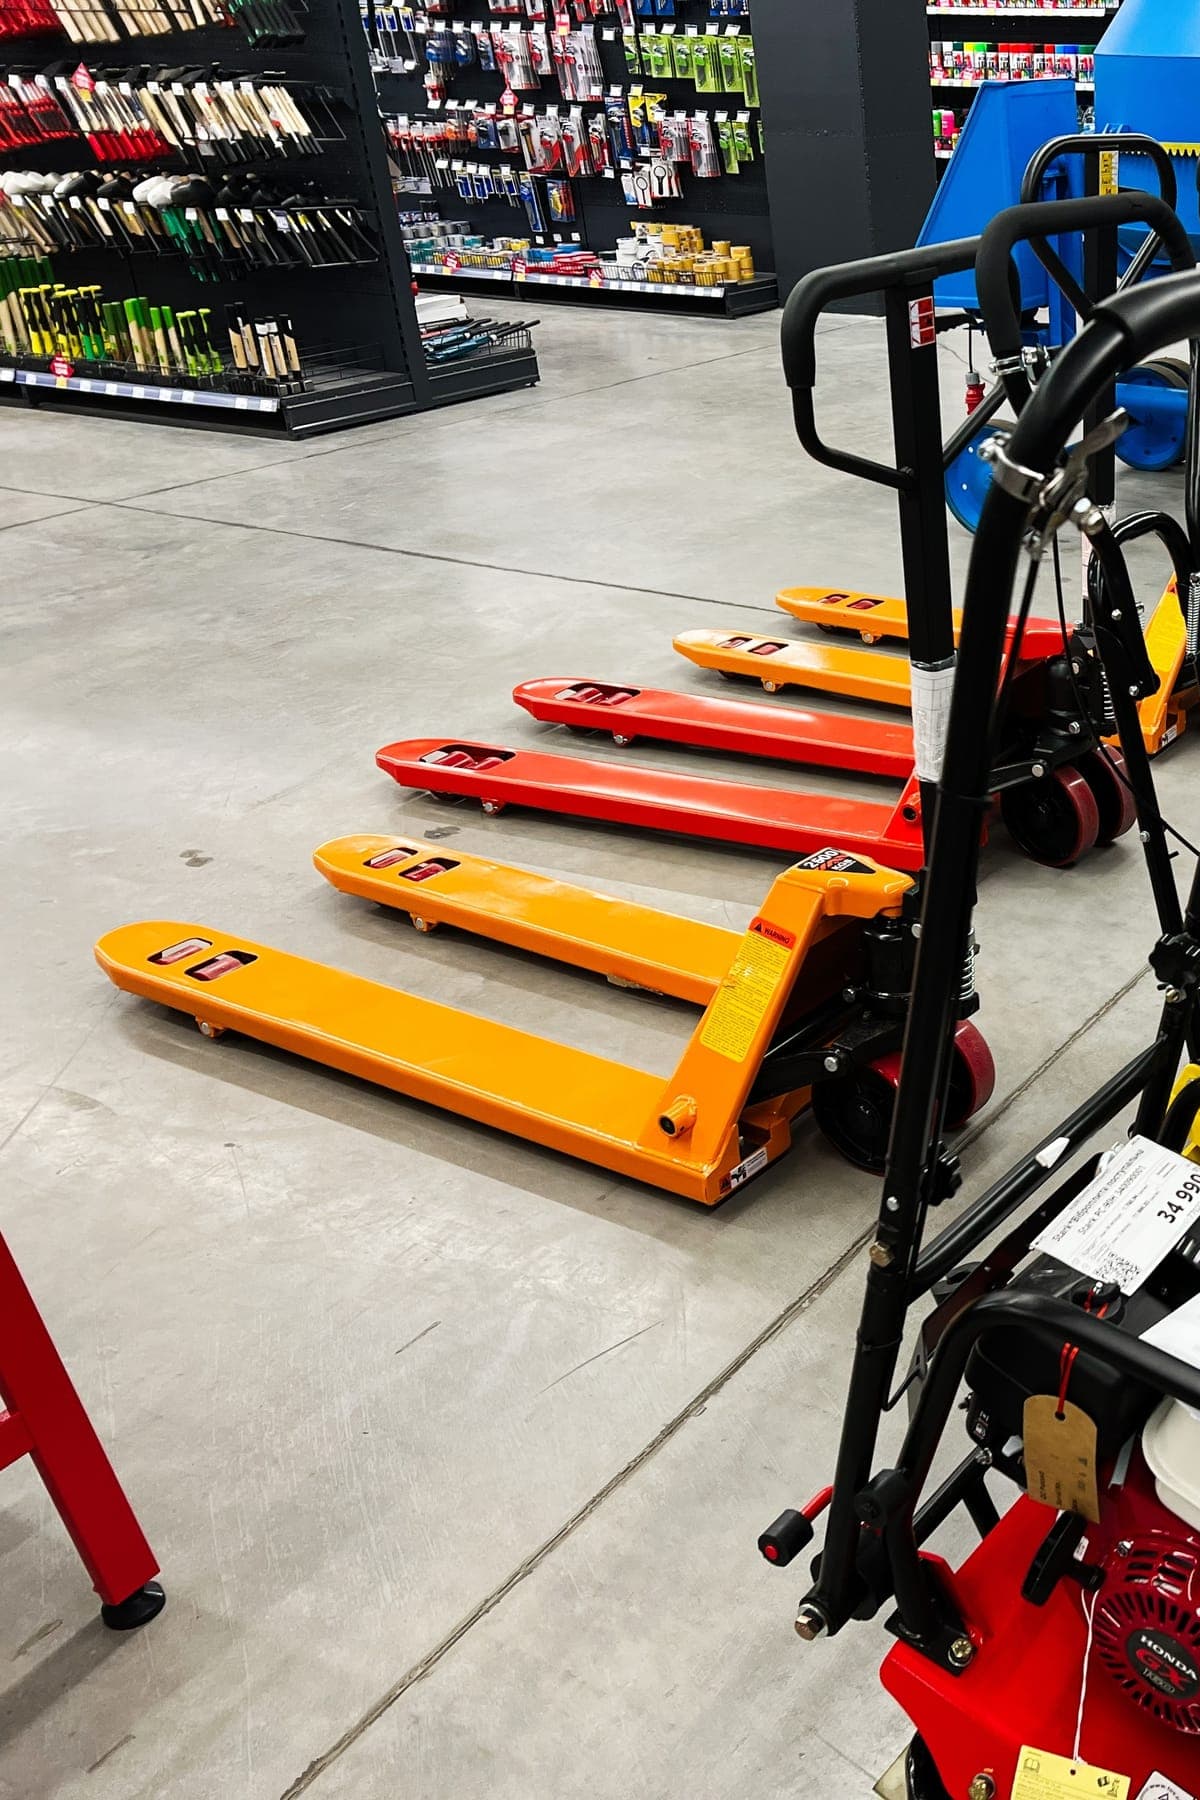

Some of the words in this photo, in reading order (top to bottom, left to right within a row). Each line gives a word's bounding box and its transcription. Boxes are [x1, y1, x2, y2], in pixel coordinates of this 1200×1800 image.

[803, 850, 839, 869] 2500
[764, 928, 790, 945] WARNING
[1156, 1200, 1184, 1224] 34
[1140, 1634, 1198, 1681] HONDA
